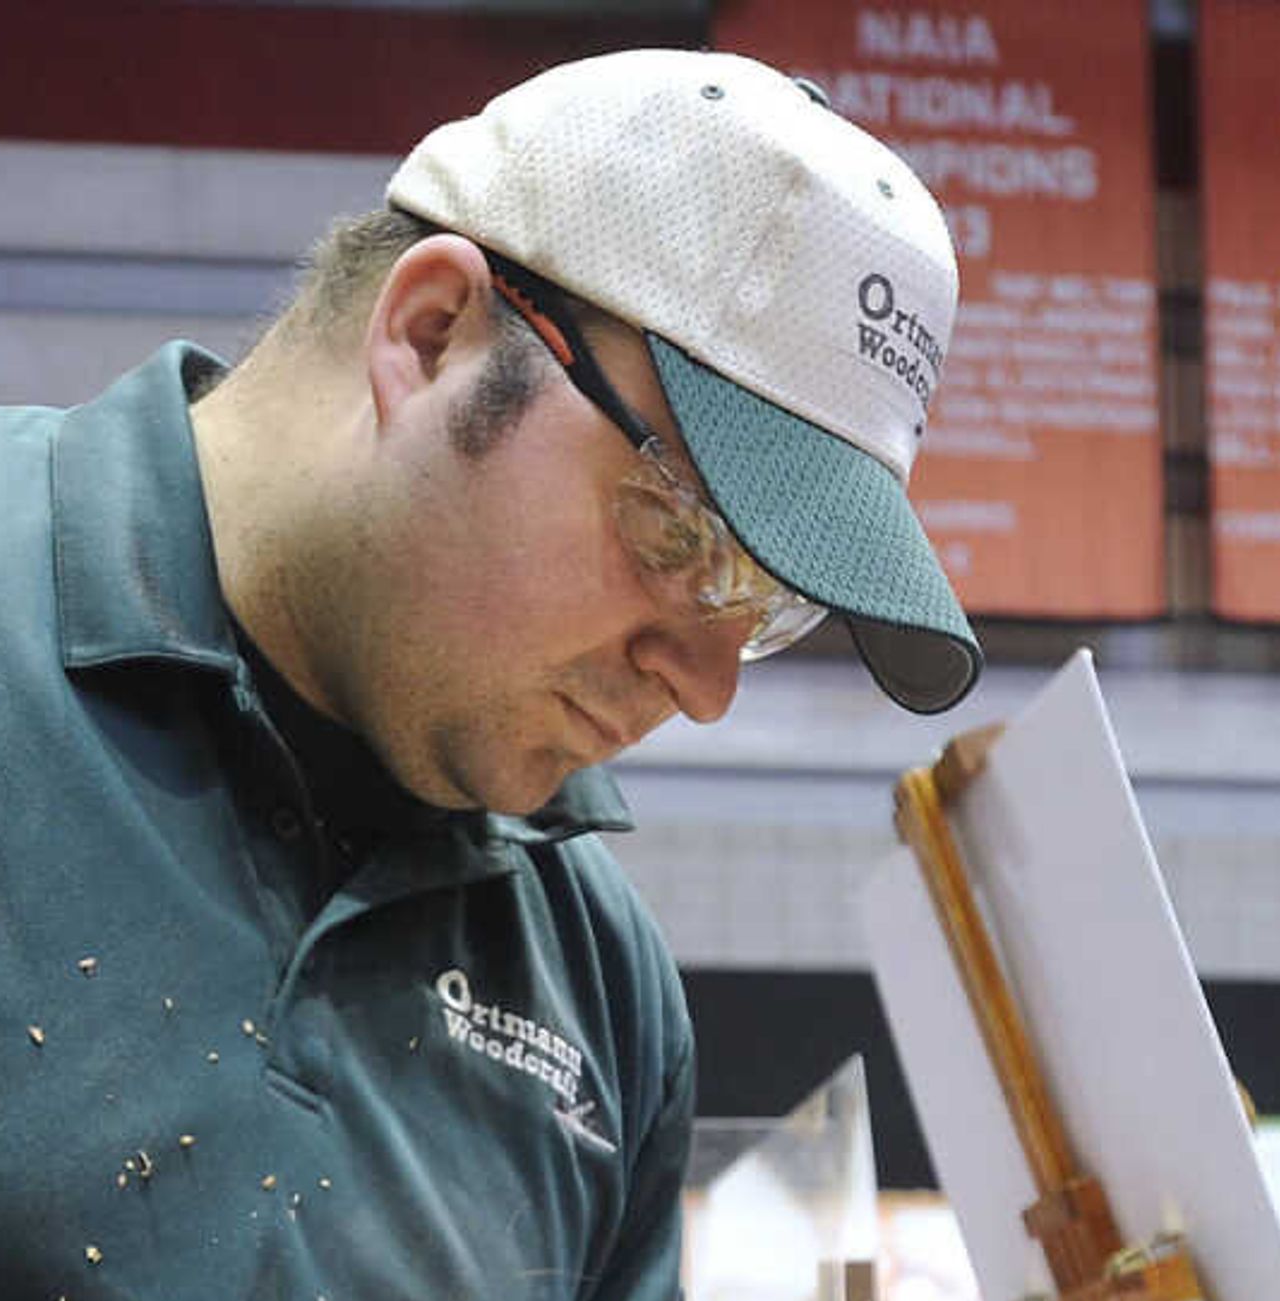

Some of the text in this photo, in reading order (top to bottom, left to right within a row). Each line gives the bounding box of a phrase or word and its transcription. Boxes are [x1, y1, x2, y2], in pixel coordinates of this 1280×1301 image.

[857, 11, 998, 64] NAIA
[802, 70, 1077, 136] ATIONAL
[888, 140, 1098, 200] PIONS
[858, 273, 944, 368] Ortma
[436, 968, 583, 1076] Ortmann
